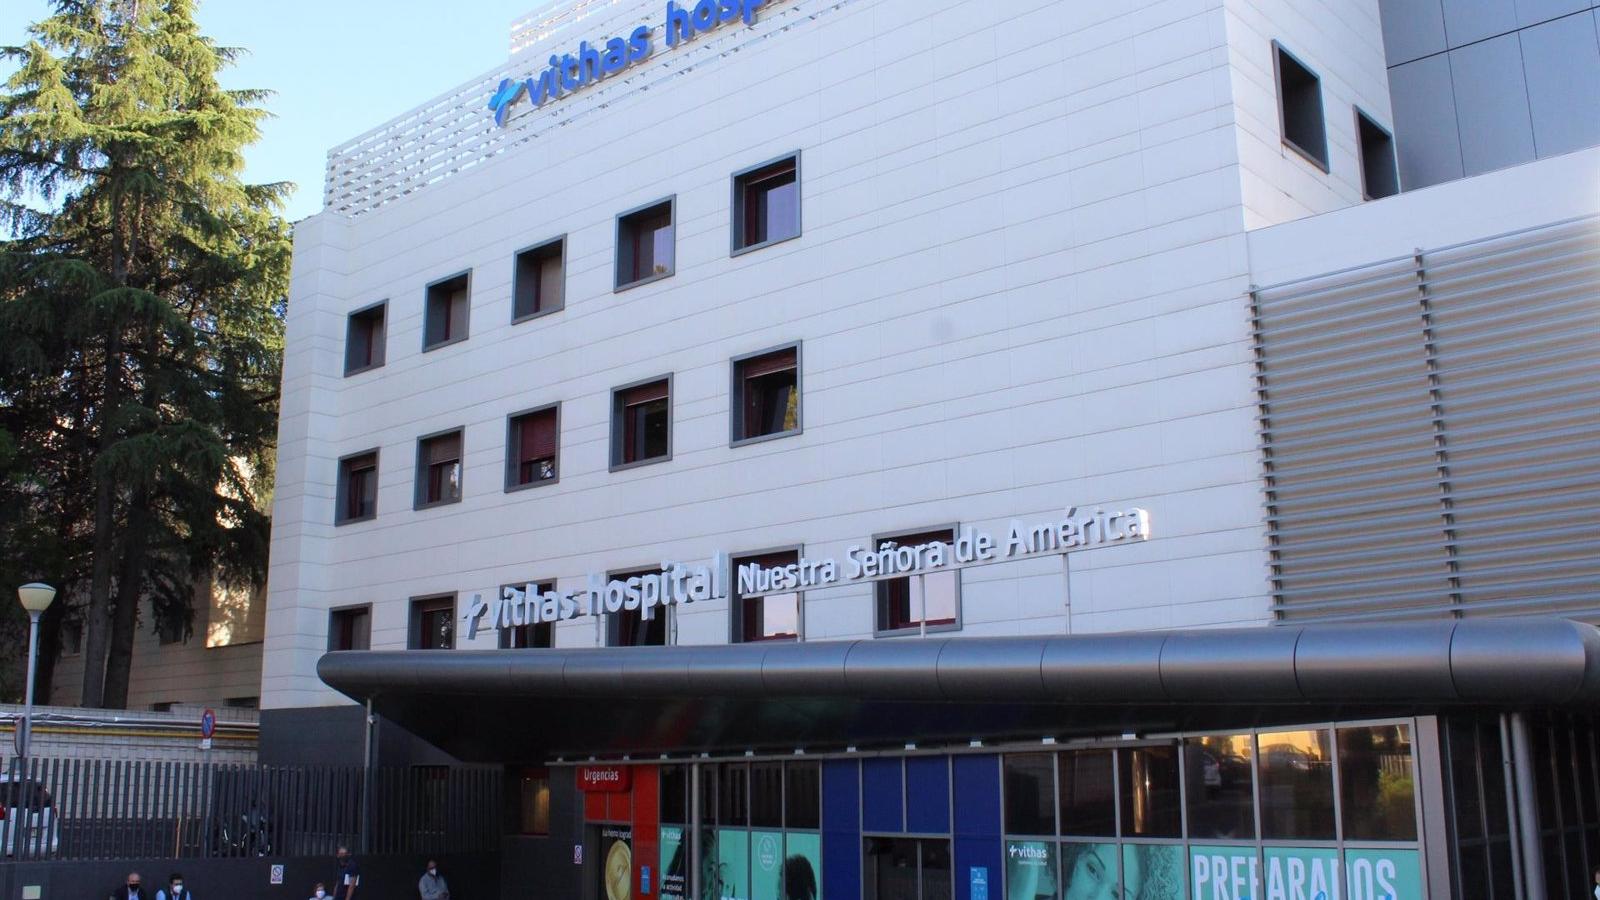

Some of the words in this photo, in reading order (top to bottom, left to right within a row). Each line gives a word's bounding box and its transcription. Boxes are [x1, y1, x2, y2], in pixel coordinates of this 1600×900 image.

[526, 25, 655, 107] vithas
[737, 560, 839, 595] Nuestra
[846, 540, 951, 580] Señora
[954, 526, 997, 562] de
[1006, 506, 1150, 556] América
[491, 584, 576, 630] vithas
[588, 551, 728, 621] hospital
[583, 769, 619, 784] Urgencias
[1018, 845, 1047, 858] vithas
